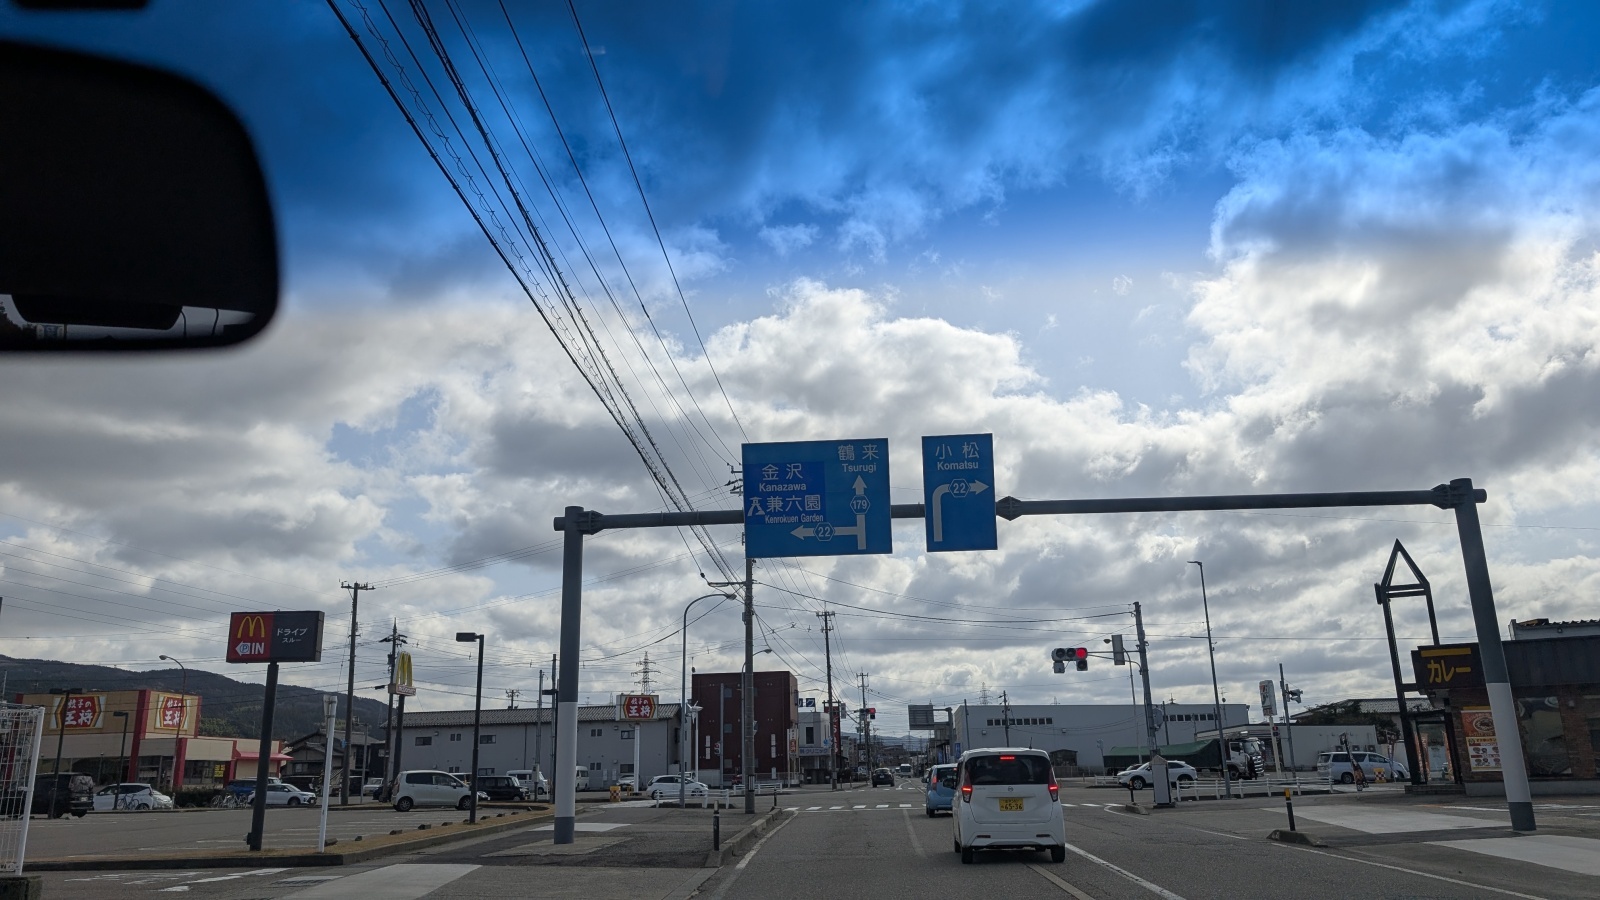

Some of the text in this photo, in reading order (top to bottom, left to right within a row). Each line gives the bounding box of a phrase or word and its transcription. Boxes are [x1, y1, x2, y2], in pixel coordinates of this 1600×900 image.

[837, 444, 880, 461] 鶴来
[935, 442, 980, 460] 小松
[841, 463, 877, 474] Tsurugi
[937, 460, 979, 471] Komatsu
[762, 463, 804, 481] 金沢
[759, 482, 807, 492] Kanazawa
[953, 482, 967, 494] 22
[766, 494, 821, 513] 兼六園
[852, 500, 868, 510] 179
[765, 513, 824, 524] Kenrokuen Garden
[818, 526, 831, 538] 22
[277, 628, 308, 637] ドライブ
[251, 642, 265, 655] IN
[1427, 659, 1472, 684] カレー
[64, 709, 94, 725] 王将
[628, 705, 651, 717] 王将
[163, 710, 183, 726] 王将
